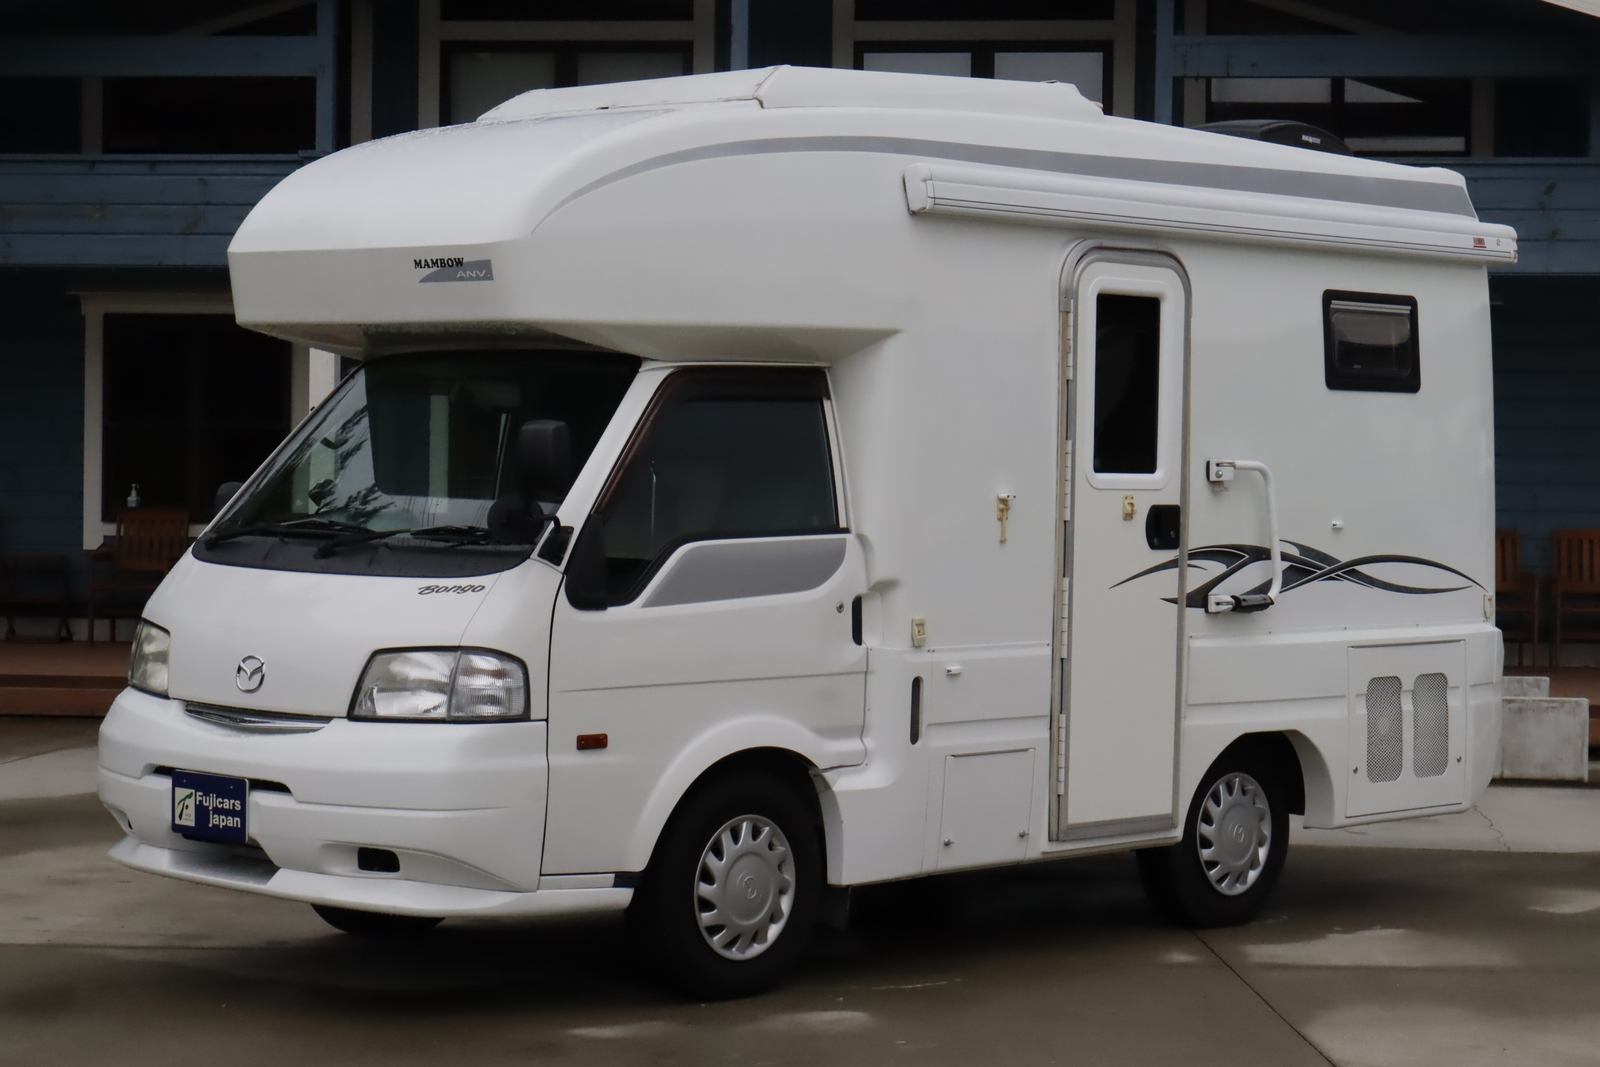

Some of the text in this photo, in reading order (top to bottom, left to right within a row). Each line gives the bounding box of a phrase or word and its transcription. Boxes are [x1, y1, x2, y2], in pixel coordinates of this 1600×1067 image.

[414, 257, 464, 269] MAMBOW
[417, 584, 486, 595] Bongo
[196, 791, 241, 810] Fujicars
[208, 810, 241, 828] japan
